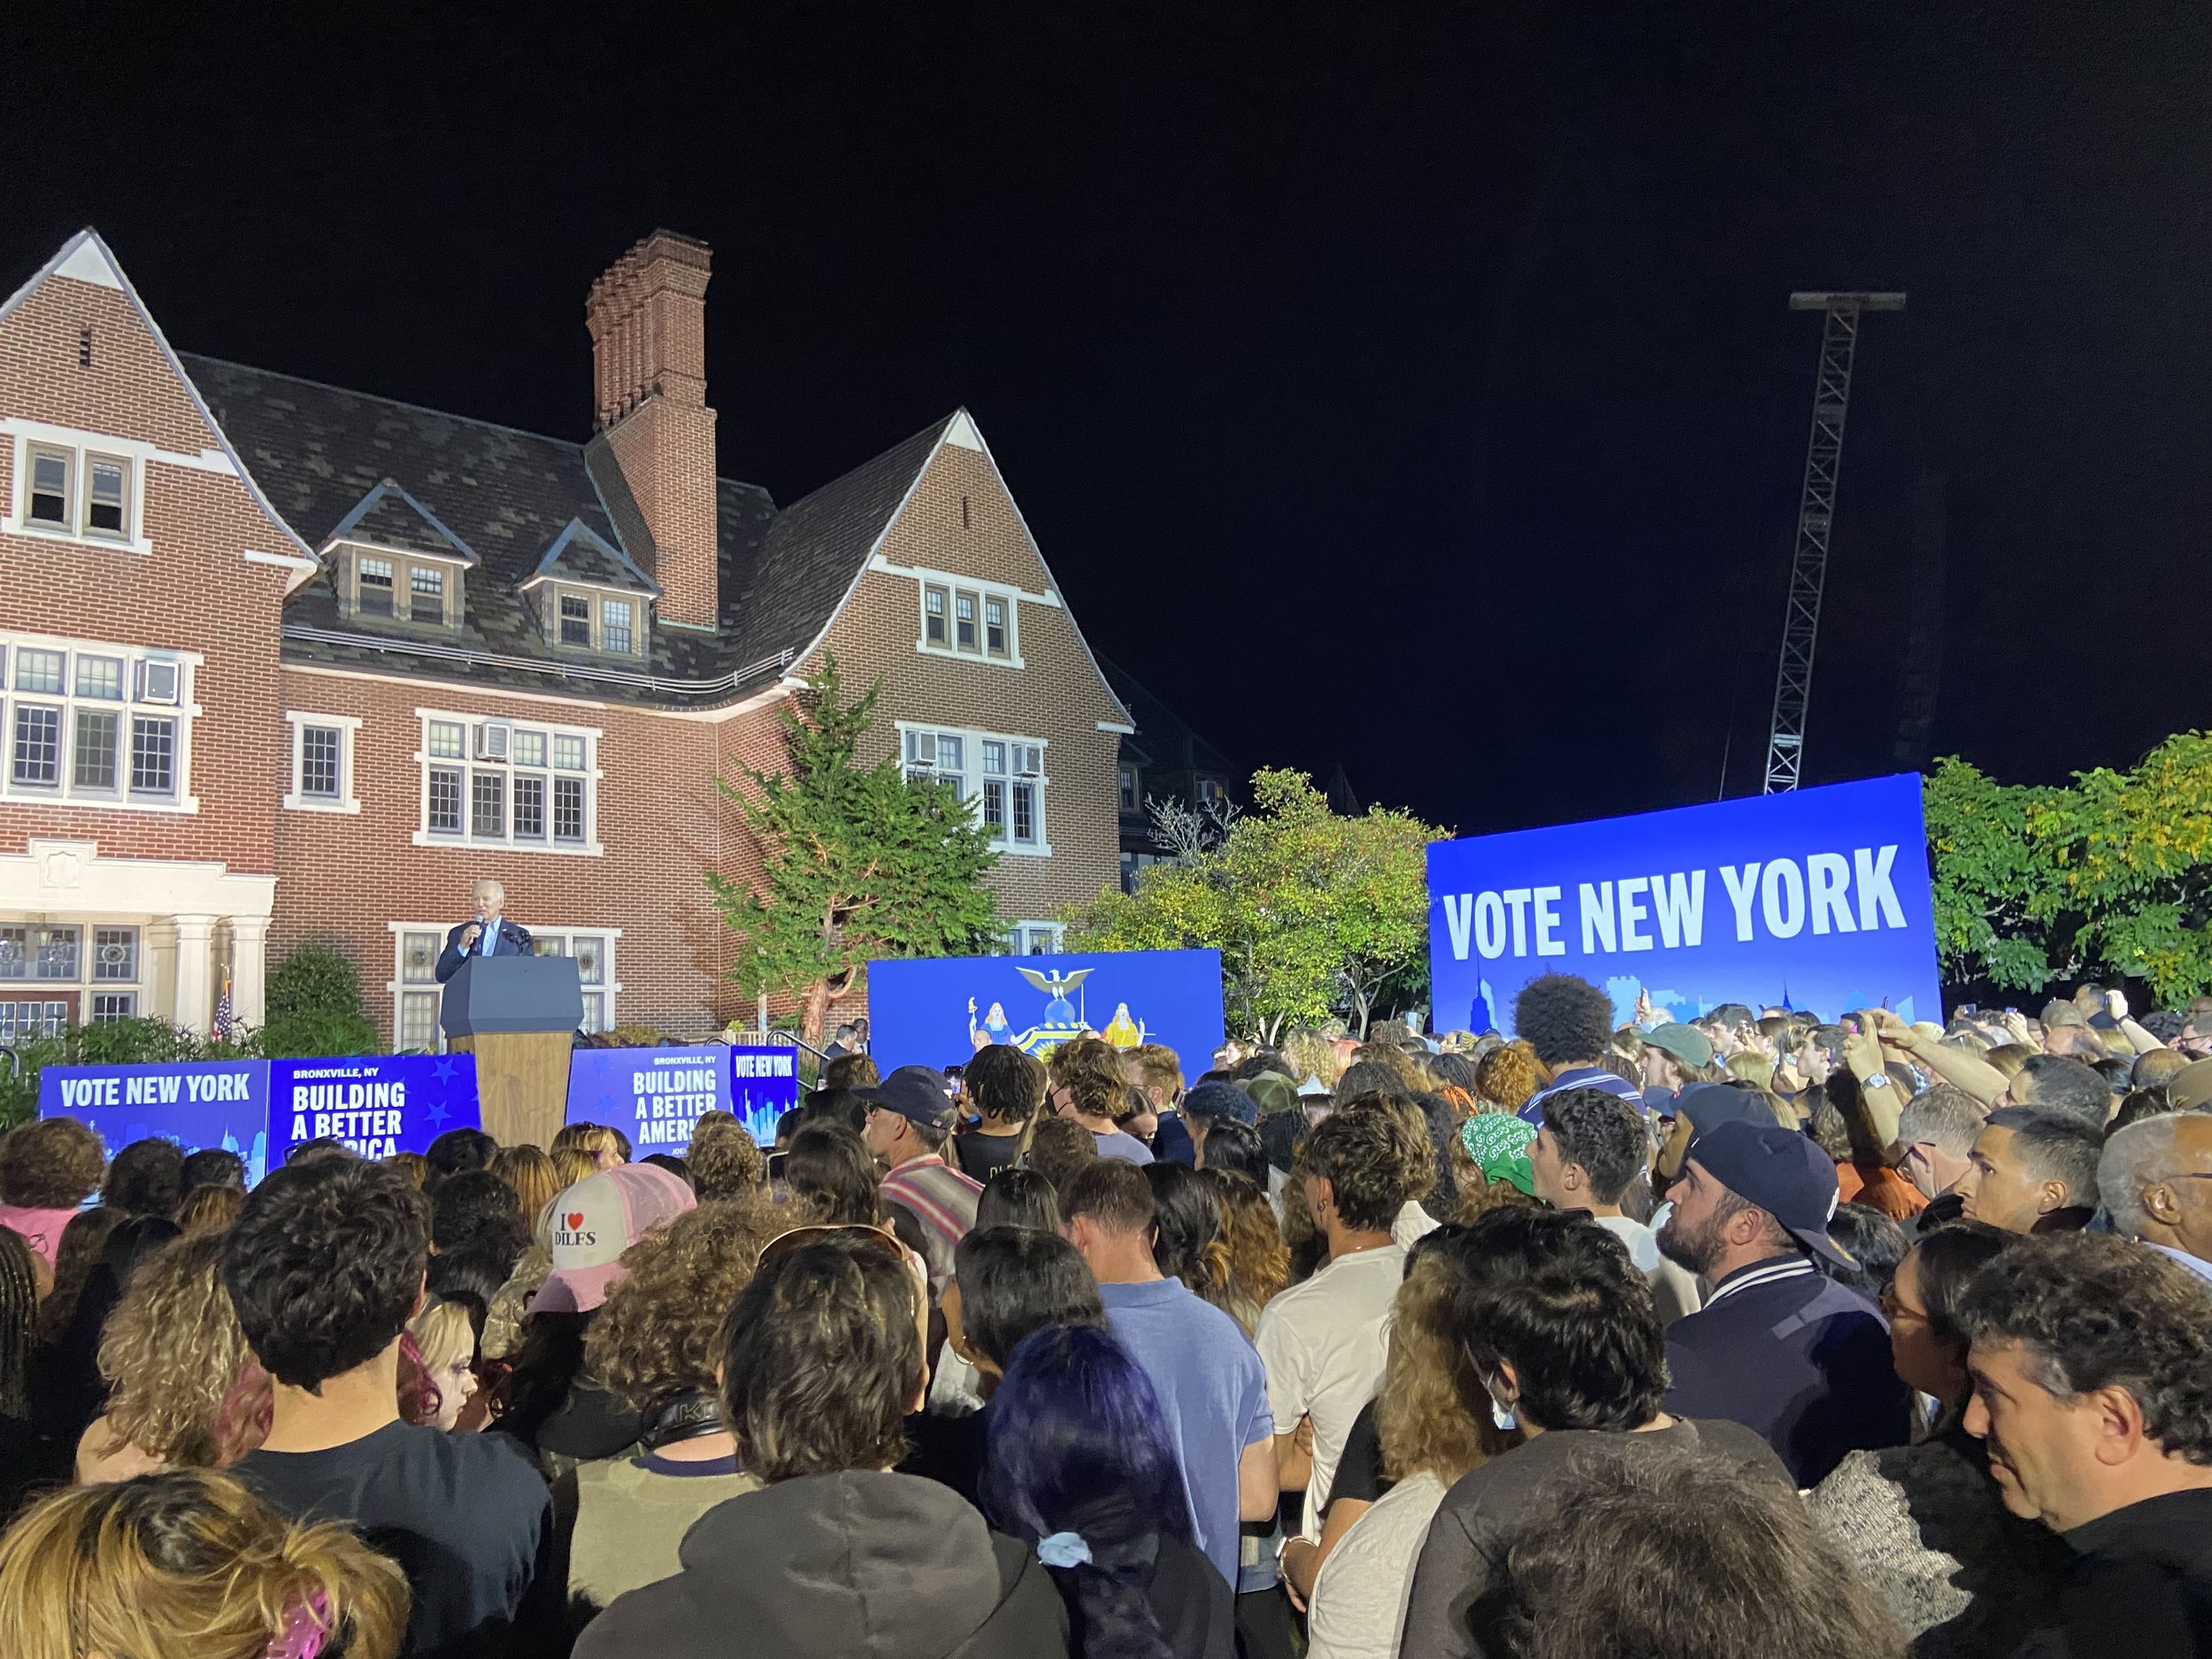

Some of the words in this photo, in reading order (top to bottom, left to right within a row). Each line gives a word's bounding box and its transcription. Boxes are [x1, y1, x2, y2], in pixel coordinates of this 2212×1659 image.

[1444, 886, 1565, 960] VOTE
[1579, 869, 1705, 954] NEW
[1719, 844, 1908, 942] YORK
[654, 1056, 703, 1065] BRONXVILLE,
[736, 1056, 755, 1078] VOTE
[756, 1056, 772, 1077] NEW
[773, 1056, 793, 1077] YORK
[293, 1067, 362, 1079] BRONXVILLE,
[364, 1067, 379, 1077] NY
[634, 1070, 716, 1094] BUILDING
[60, 1078, 120, 1107] VOTE
[126, 1076, 181, 1104] NEW
[186, 1073, 250, 1102] YORK
[293, 1082, 405, 1111] BUILDING
[635, 1097, 648, 1119] A
[652, 1094, 717, 1118] BETTER
[291, 1114, 307, 1141] A
[315, 1110, 403, 1139] BETTER
[560, 1213, 566, 1231] I
[555, 1232, 596, 1247] DILFS
